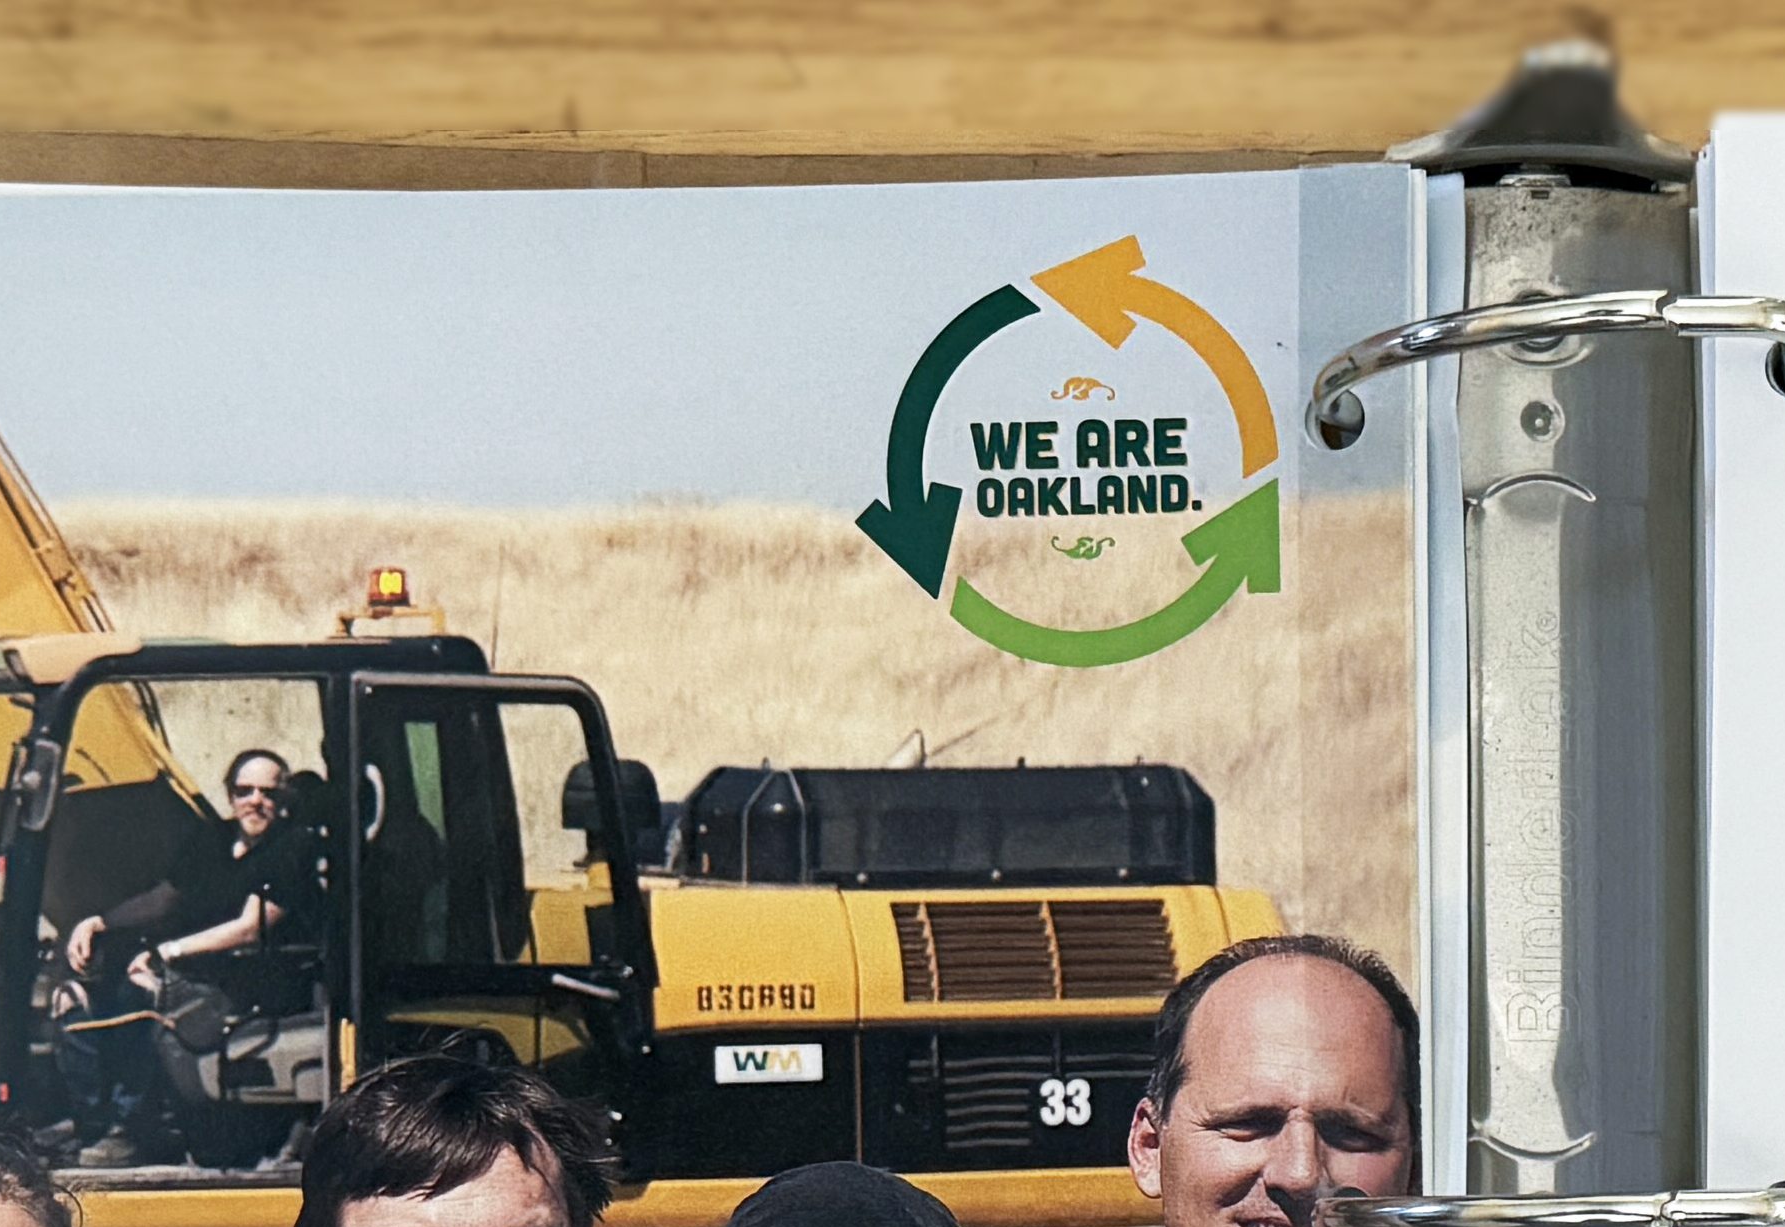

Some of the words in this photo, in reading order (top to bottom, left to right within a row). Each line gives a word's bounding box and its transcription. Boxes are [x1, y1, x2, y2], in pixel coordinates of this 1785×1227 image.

[970, 421, 1059, 470] WE
[1075, 418, 1188, 468] ARE
[976, 474, 1202, 517] OAKLAND.
[733, 1049, 803, 1072] WM
[1039, 1078, 1091, 1126] 33
